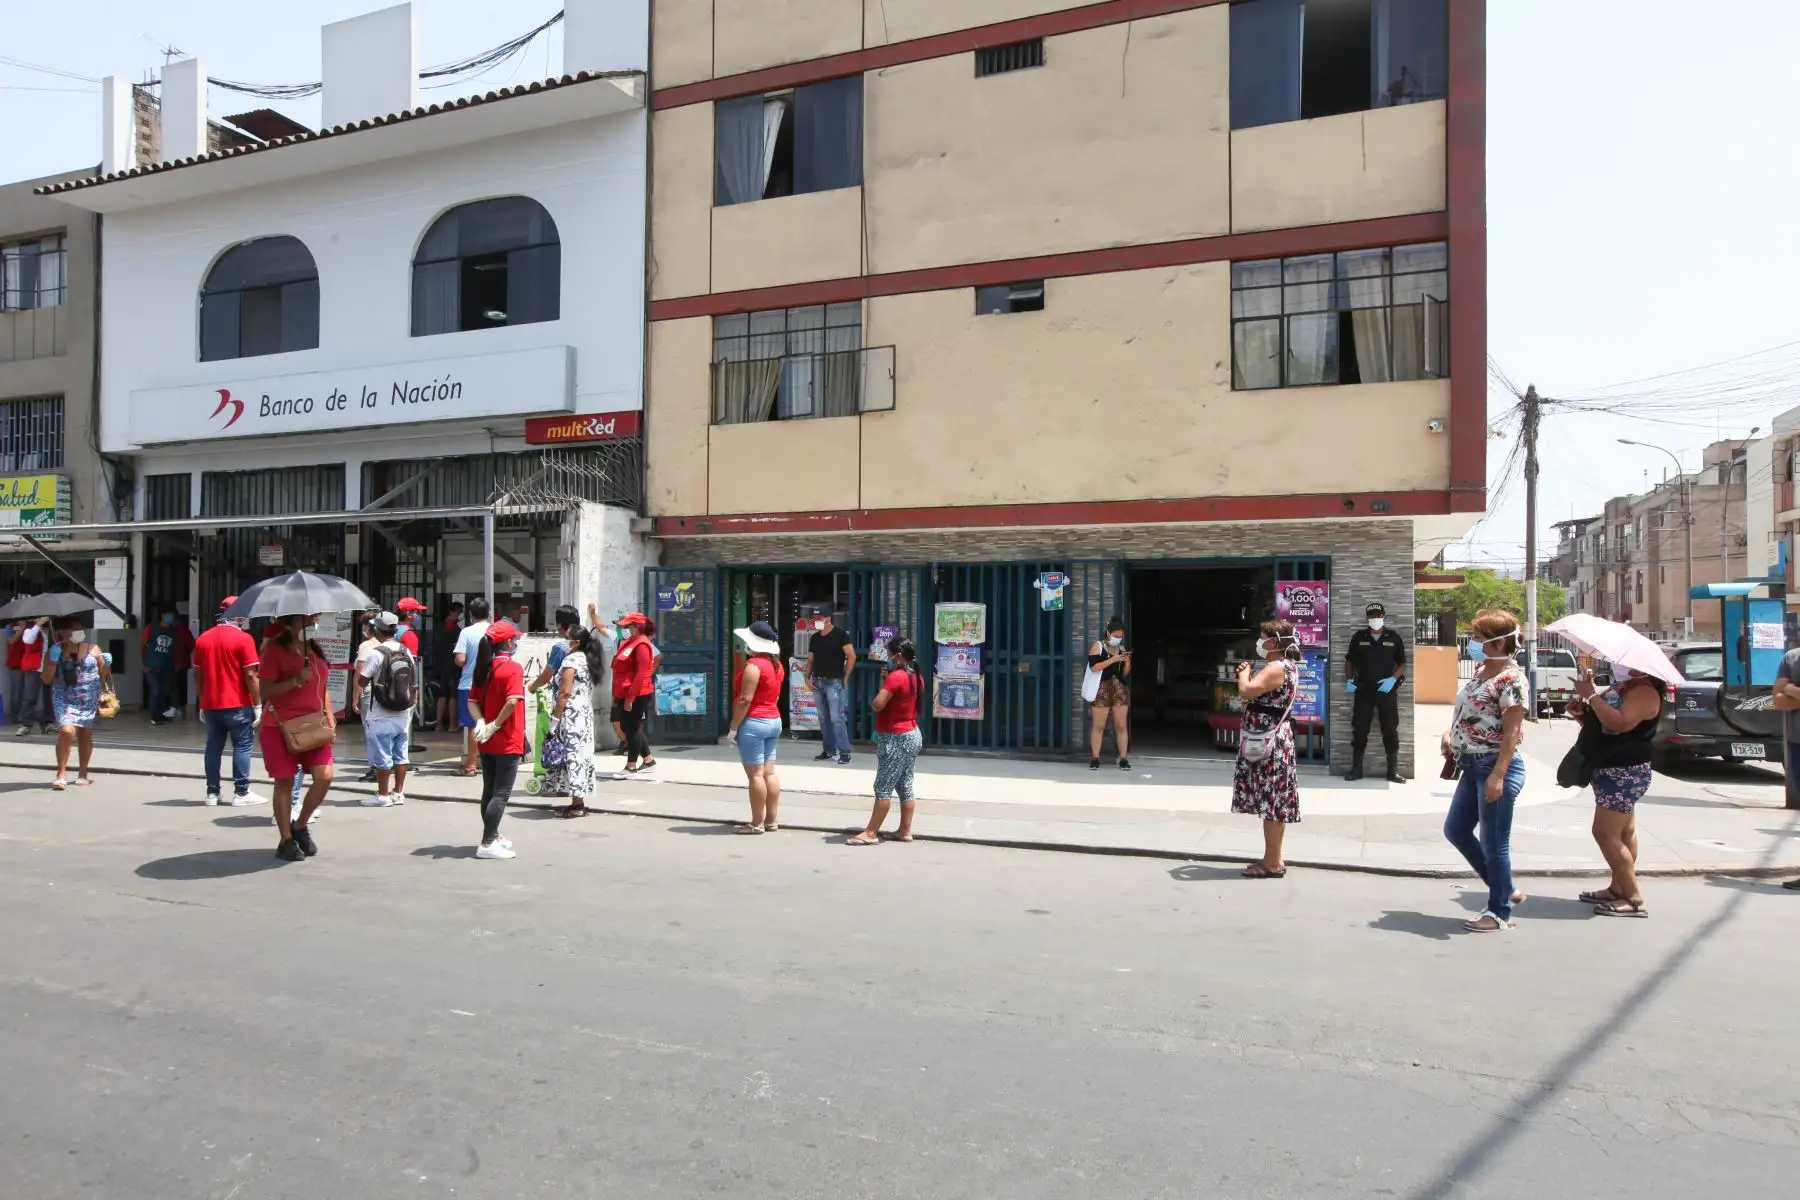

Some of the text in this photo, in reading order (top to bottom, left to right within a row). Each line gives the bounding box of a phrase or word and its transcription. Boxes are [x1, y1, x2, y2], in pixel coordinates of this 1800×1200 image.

[259, 374, 462, 417] Banco de la Nación
[546, 418, 615, 438] multiRed
[1290, 595, 1315, 603] 1,000
